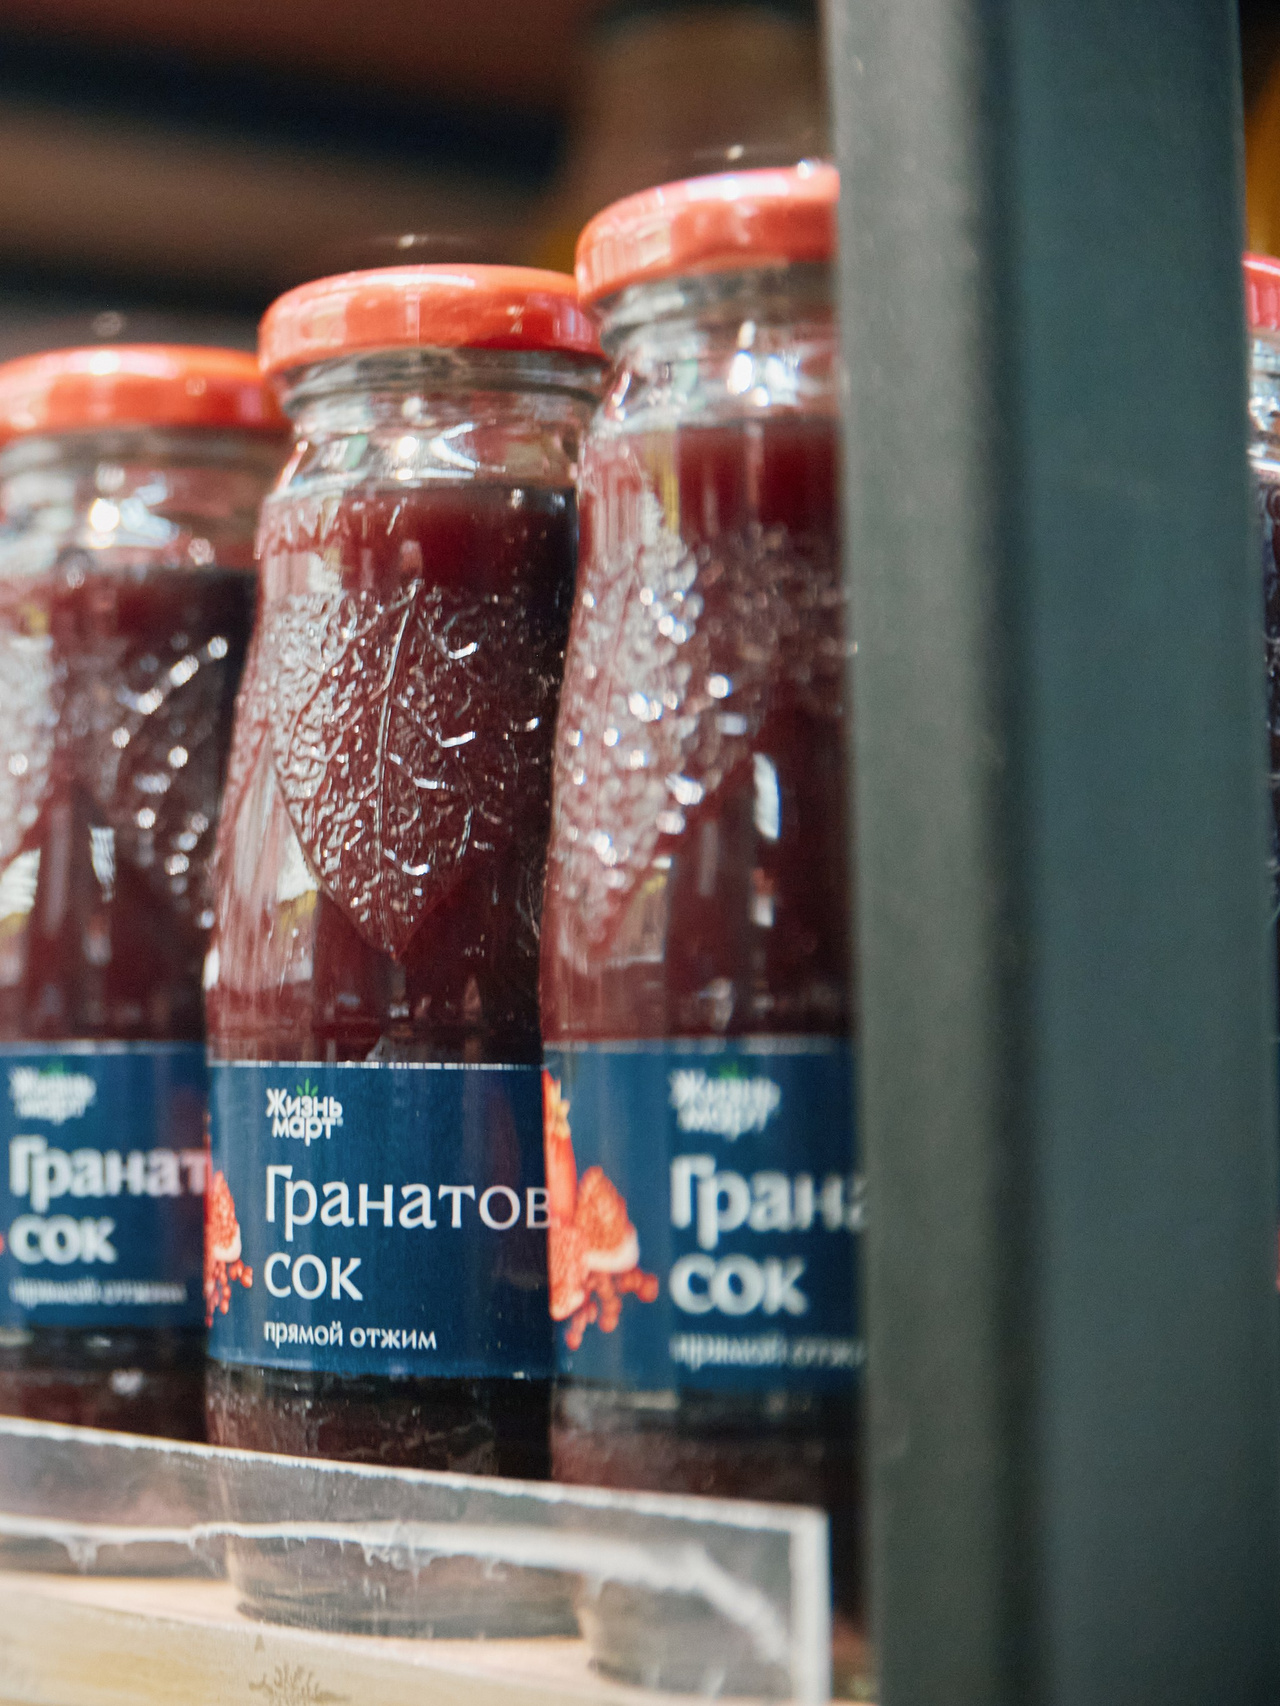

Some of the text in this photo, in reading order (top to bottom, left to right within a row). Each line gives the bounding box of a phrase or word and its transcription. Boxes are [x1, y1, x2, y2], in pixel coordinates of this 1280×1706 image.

[266, 1088, 343, 1118] Жизнь
[272, 1116, 333, 1147] март
[10, 1215, 117, 1264] сок
[264, 1252, 363, 1300] сок
[670, 1253, 807, 1316] сок
[264, 1321, 437, 1350] прямой отжим
